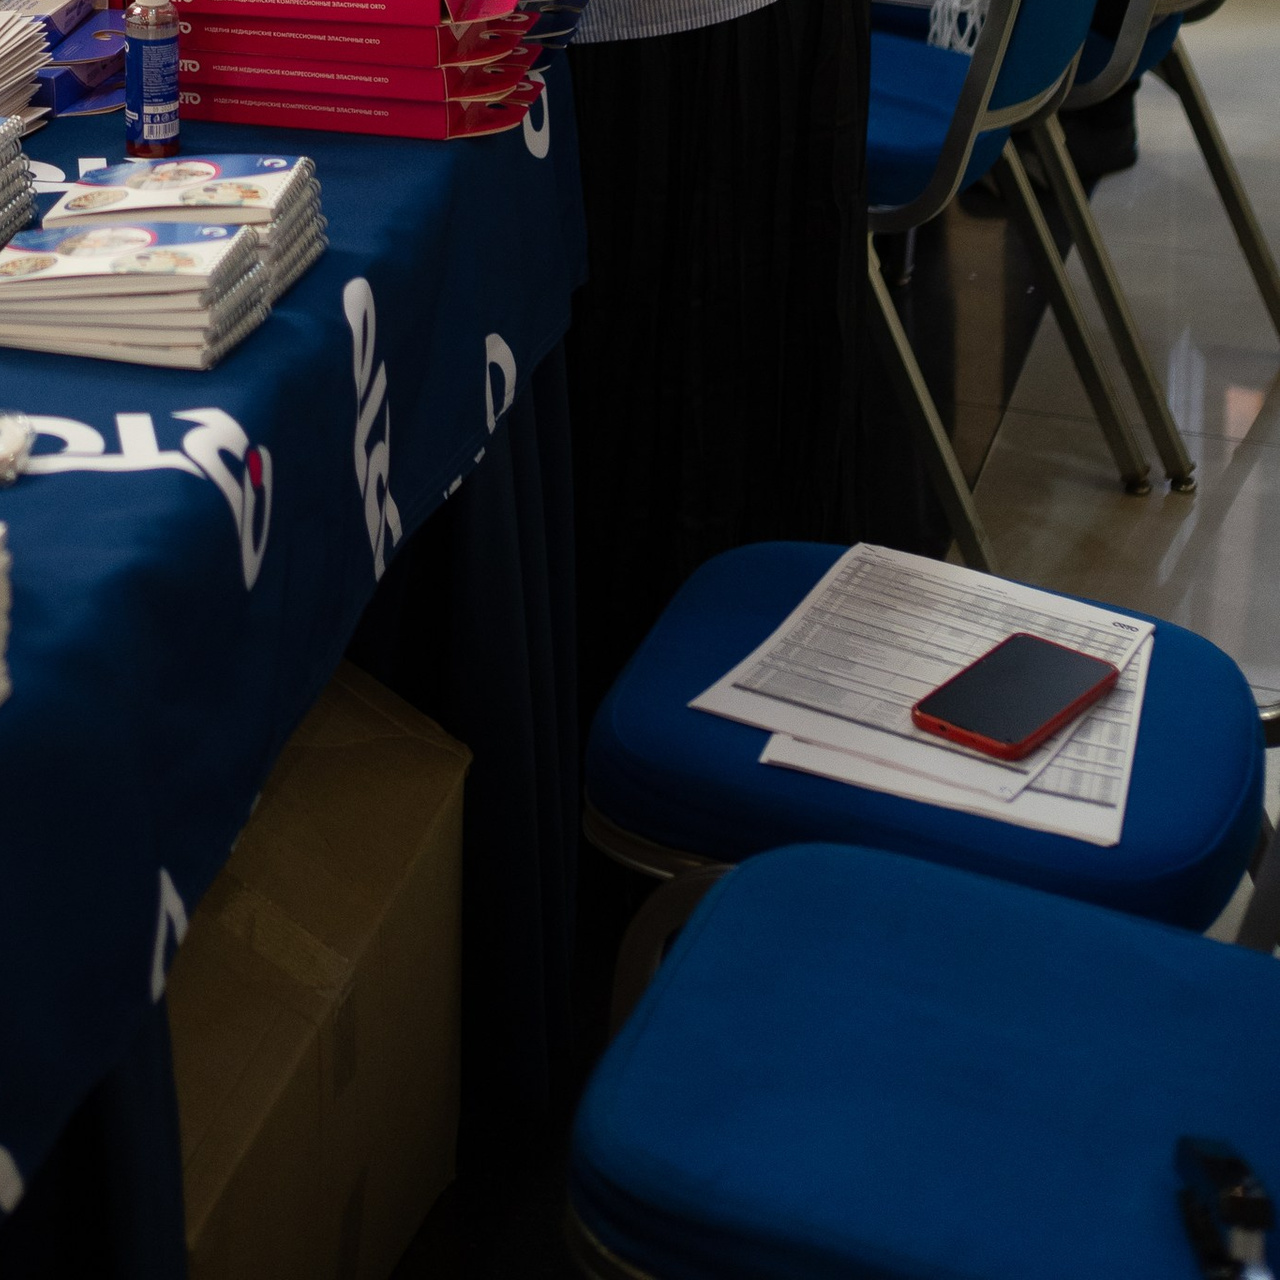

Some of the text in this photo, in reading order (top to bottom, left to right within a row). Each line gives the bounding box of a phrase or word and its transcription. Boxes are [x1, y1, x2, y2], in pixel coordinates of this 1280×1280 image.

[332, 1, 370, 9] ЭЛАСТИЧНЫЕ
[204, 26, 230, 34] ИЗДЕЛИЯ
[230, 28, 272, 37] МЕДИЦИНСКИЕ
[273, 31, 326, 41] КОМПРЕССИОННЫЕ
[327, 35, 364, 44] ЭЛАСТИЧНЫЕ
[212, 64, 238, 73] ИЗДЕЛИЯ
[239, 66, 280, 75] МЕДИЦИНСКИЕ
[281, 69, 335, 80] КОМПРЕССИОННЫЕ
[335, 73, 372, 83] ЭЛАСТИЧНЫЕ
[213, 96, 239, 105] ИЗДЕЛИЯ
[239, 99, 281, 108] МЕДИЦИНСКИЕ
[282, 102, 335, 113] КОМПРЕССИОННЫЕ
